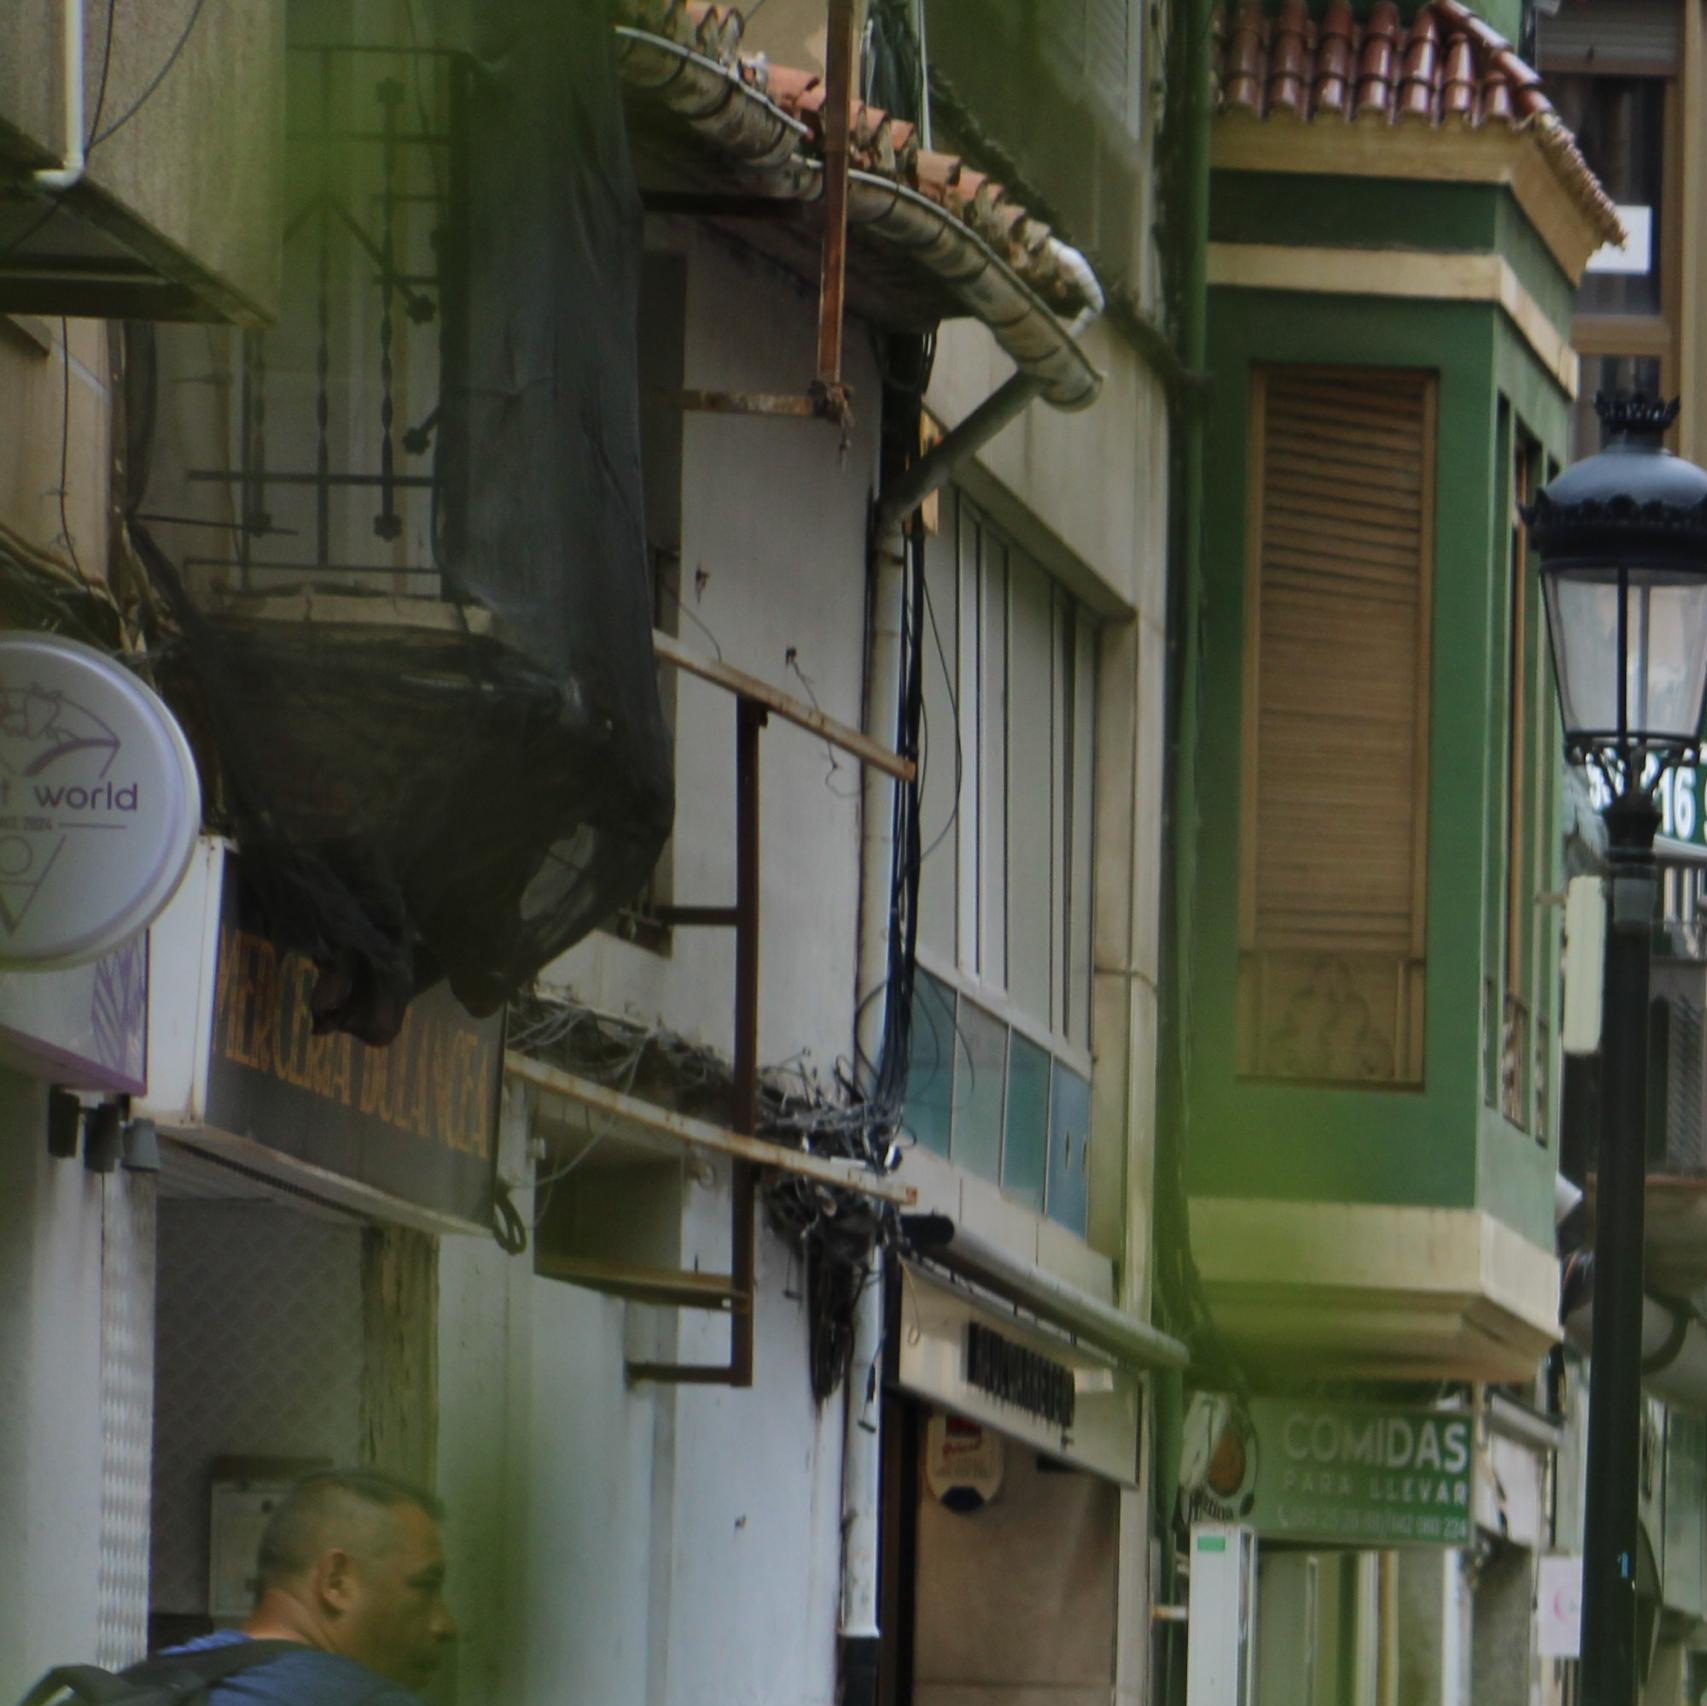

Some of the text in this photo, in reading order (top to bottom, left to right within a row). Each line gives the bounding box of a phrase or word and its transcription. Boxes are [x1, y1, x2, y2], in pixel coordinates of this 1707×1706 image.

[34, 782, 138, 811] world
[1284, 1415, 1468, 1474] COMIDAS
[1370, 1477, 1468, 1506] LLEVAR
